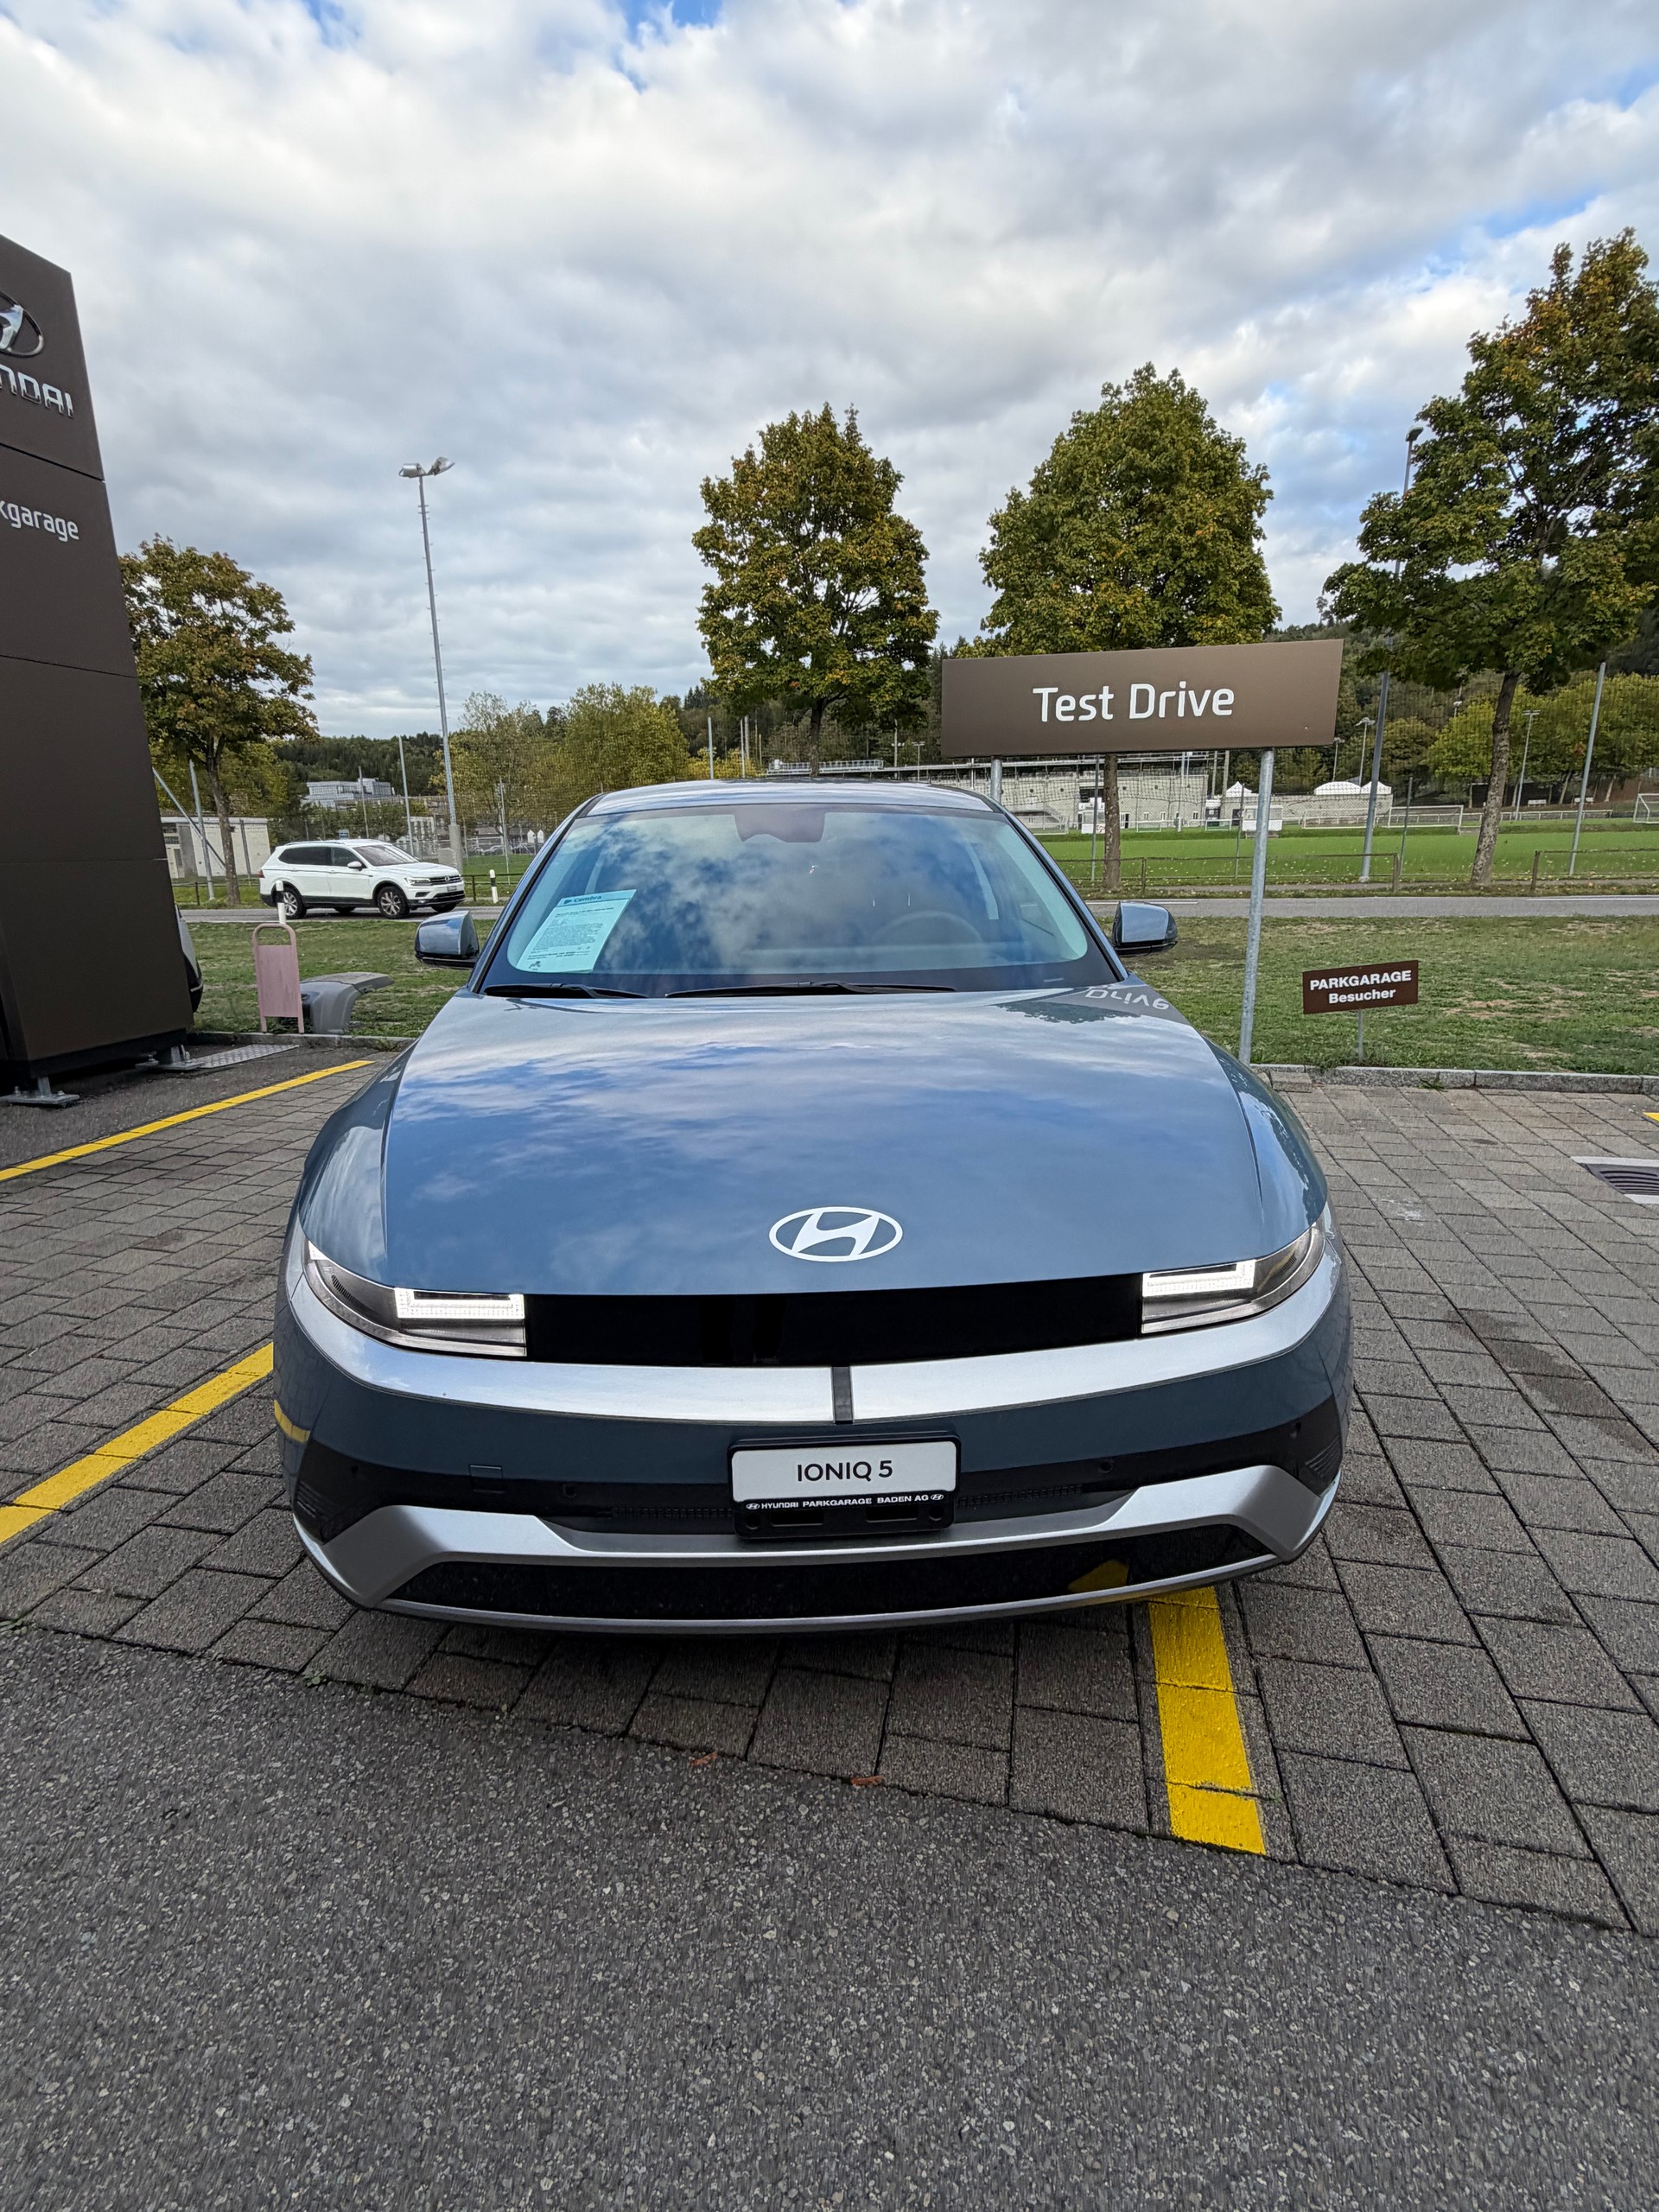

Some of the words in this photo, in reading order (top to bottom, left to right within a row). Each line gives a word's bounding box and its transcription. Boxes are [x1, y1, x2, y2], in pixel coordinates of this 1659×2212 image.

[1033, 685, 1115, 722] Test
[1129, 681, 1235, 720] Drive
[1310, 969, 1412, 991] PARKGARAGE
[797, 1461, 872, 1482] IONIQ
[878, 1460, 893, 1478] 5
[761, 1501, 798, 1510] HYUNDAI
[802, 1497, 872, 1508] PARKGARAGE
[876, 1496, 912, 1504] BADEN
